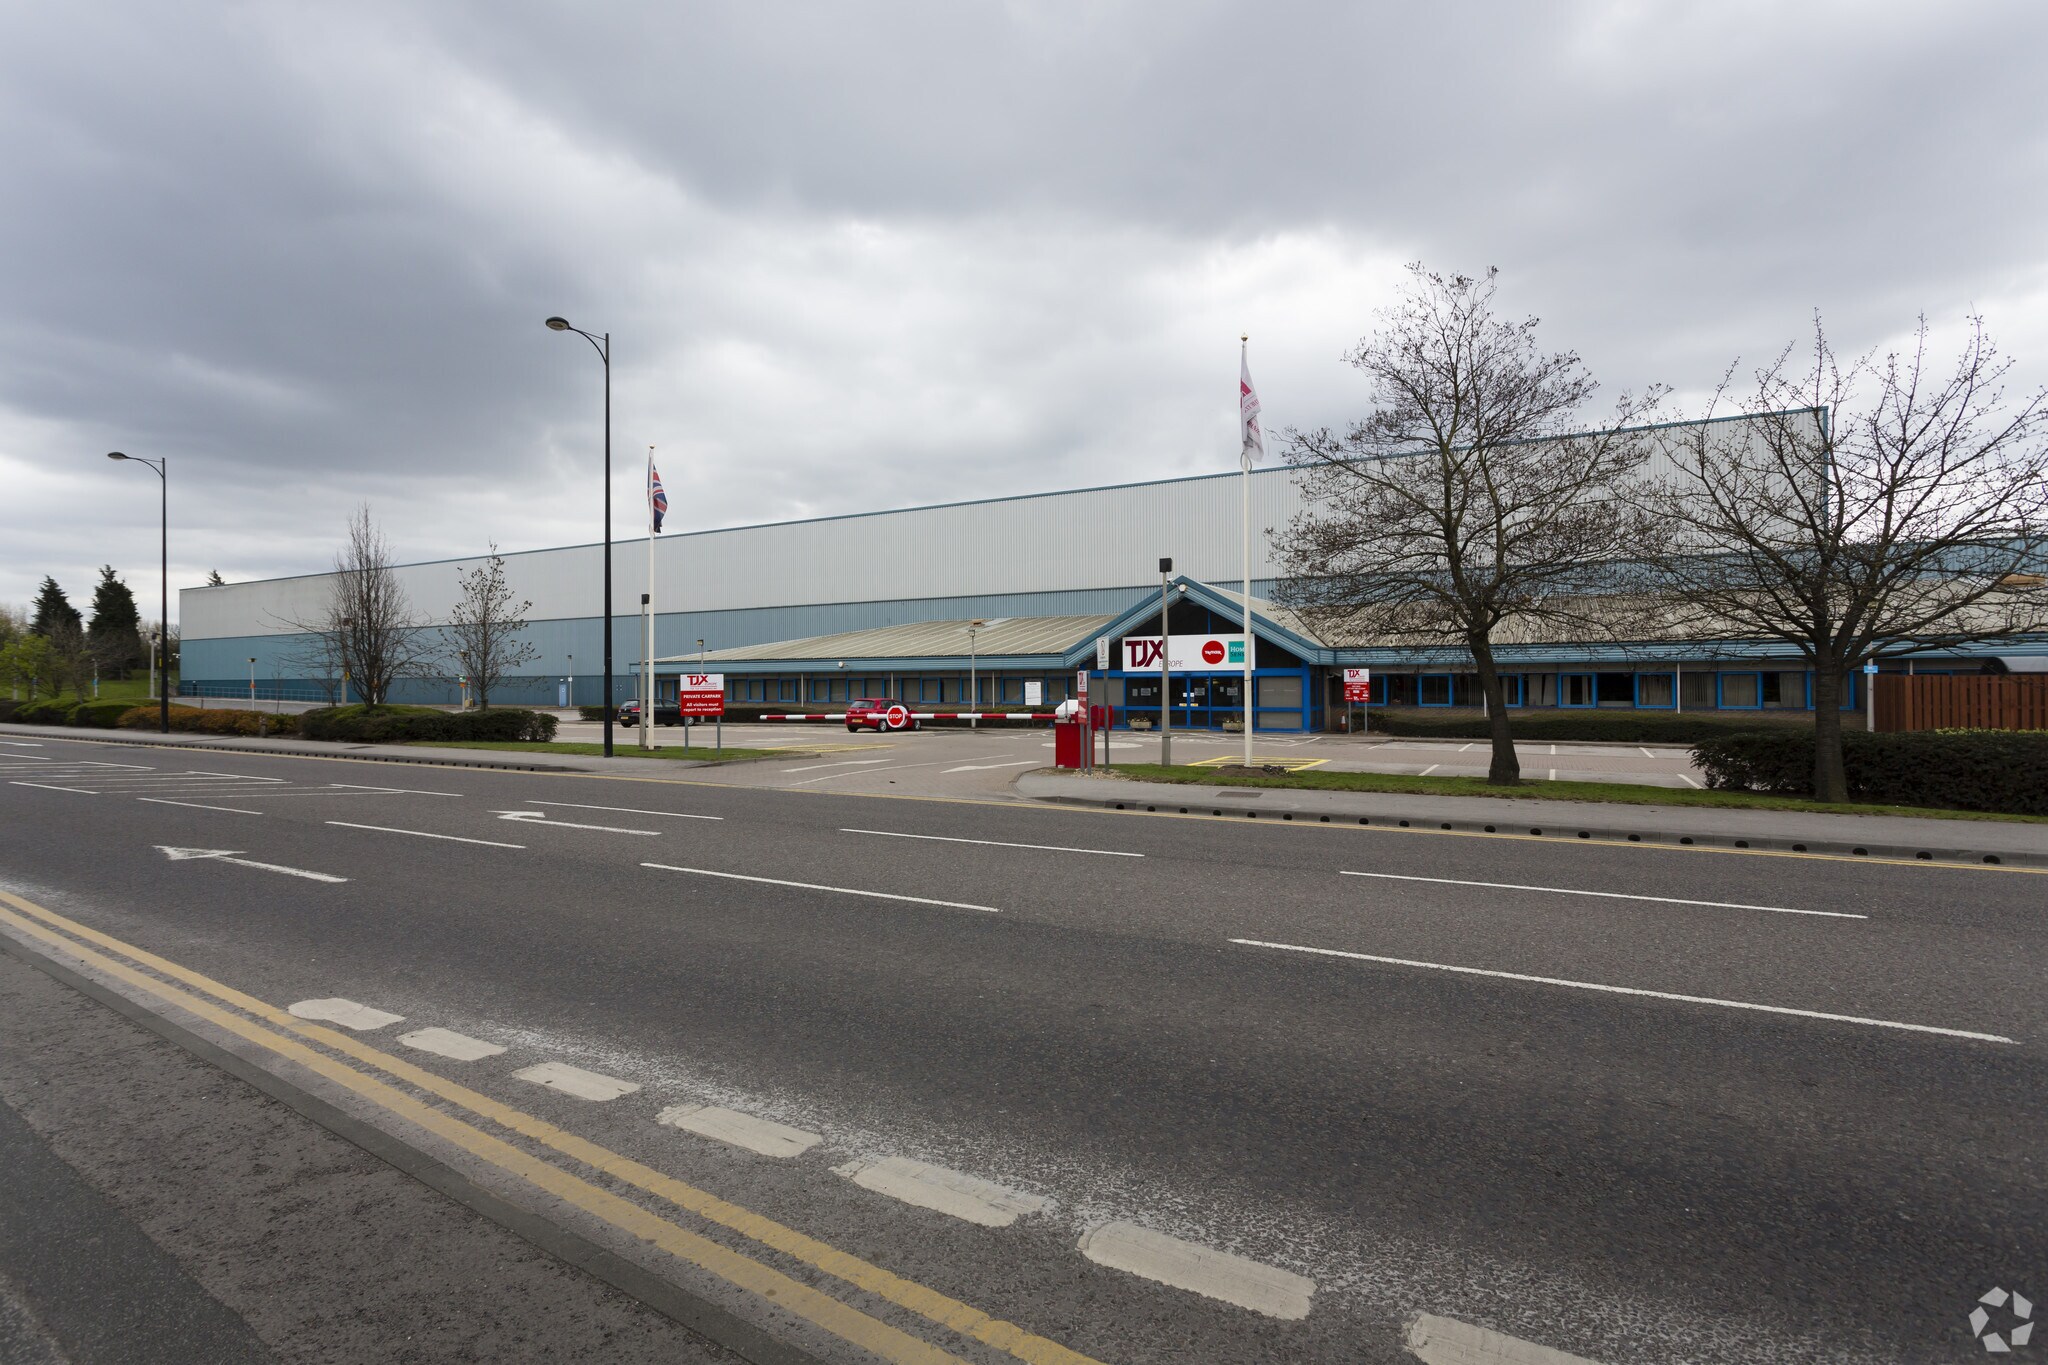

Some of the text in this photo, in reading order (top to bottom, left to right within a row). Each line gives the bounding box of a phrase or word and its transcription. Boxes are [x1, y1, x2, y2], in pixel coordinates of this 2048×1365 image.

[1125, 640, 1163, 667] TJX
[1158, 660, 1183, 668] EROPE
[1348, 670, 1360, 678] TJX
[686, 675, 708, 686] TJX
